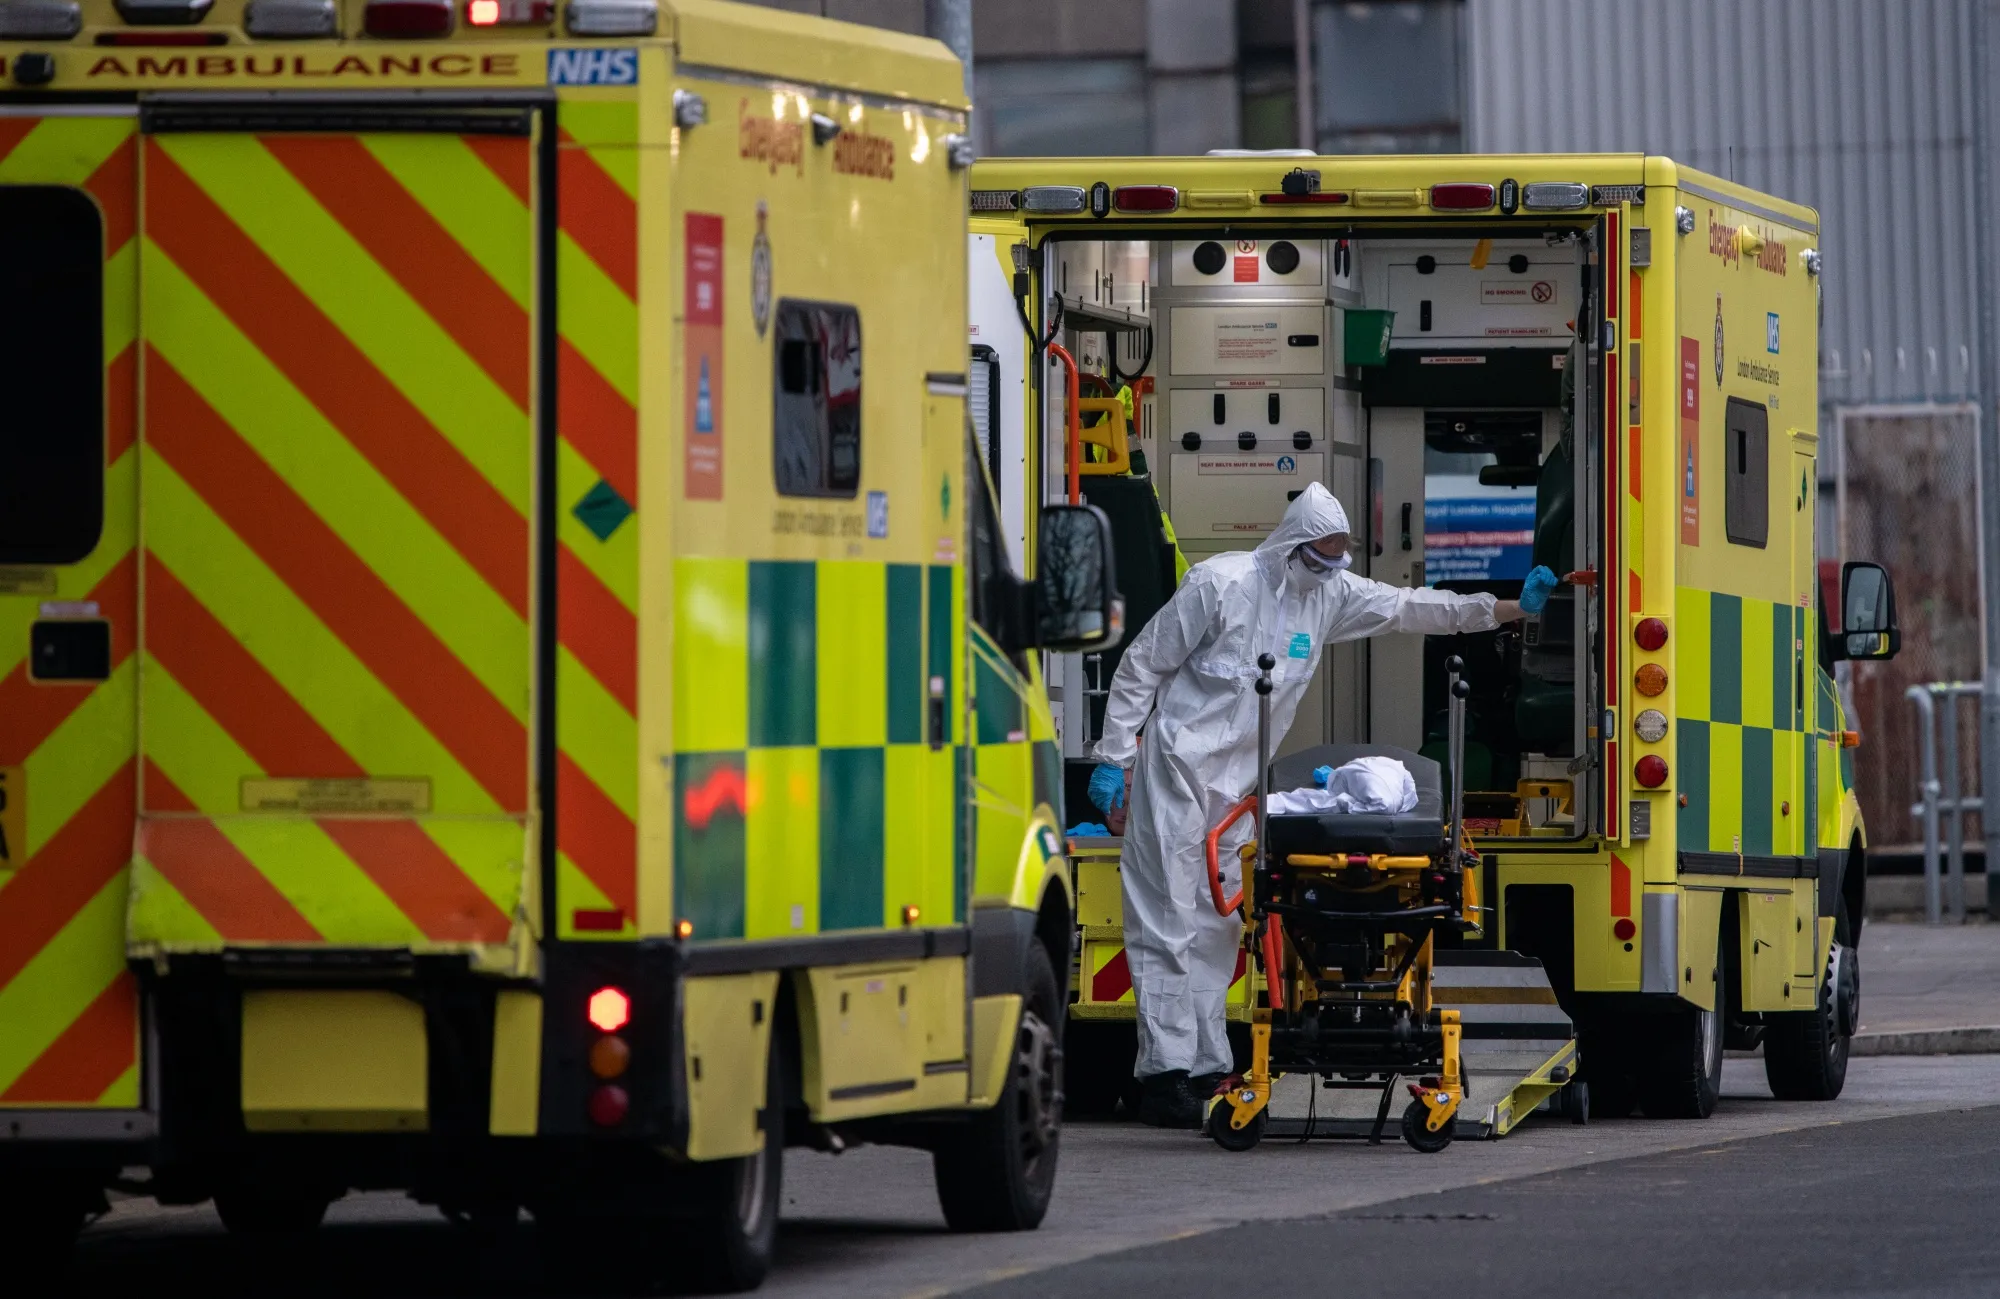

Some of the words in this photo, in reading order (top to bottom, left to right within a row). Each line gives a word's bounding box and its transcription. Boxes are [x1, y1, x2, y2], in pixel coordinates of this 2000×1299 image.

[86, 53, 519, 78] AMBULANCE
[549, 49, 638, 85] NHS
[1709, 208, 1739, 270] Emergency
[1767, 312, 1779, 354] NHS
[1738, 356, 1749, 378] London
[1750, 359, 1768, 383] Ambulance
[1768, 363, 1779, 386] Service
